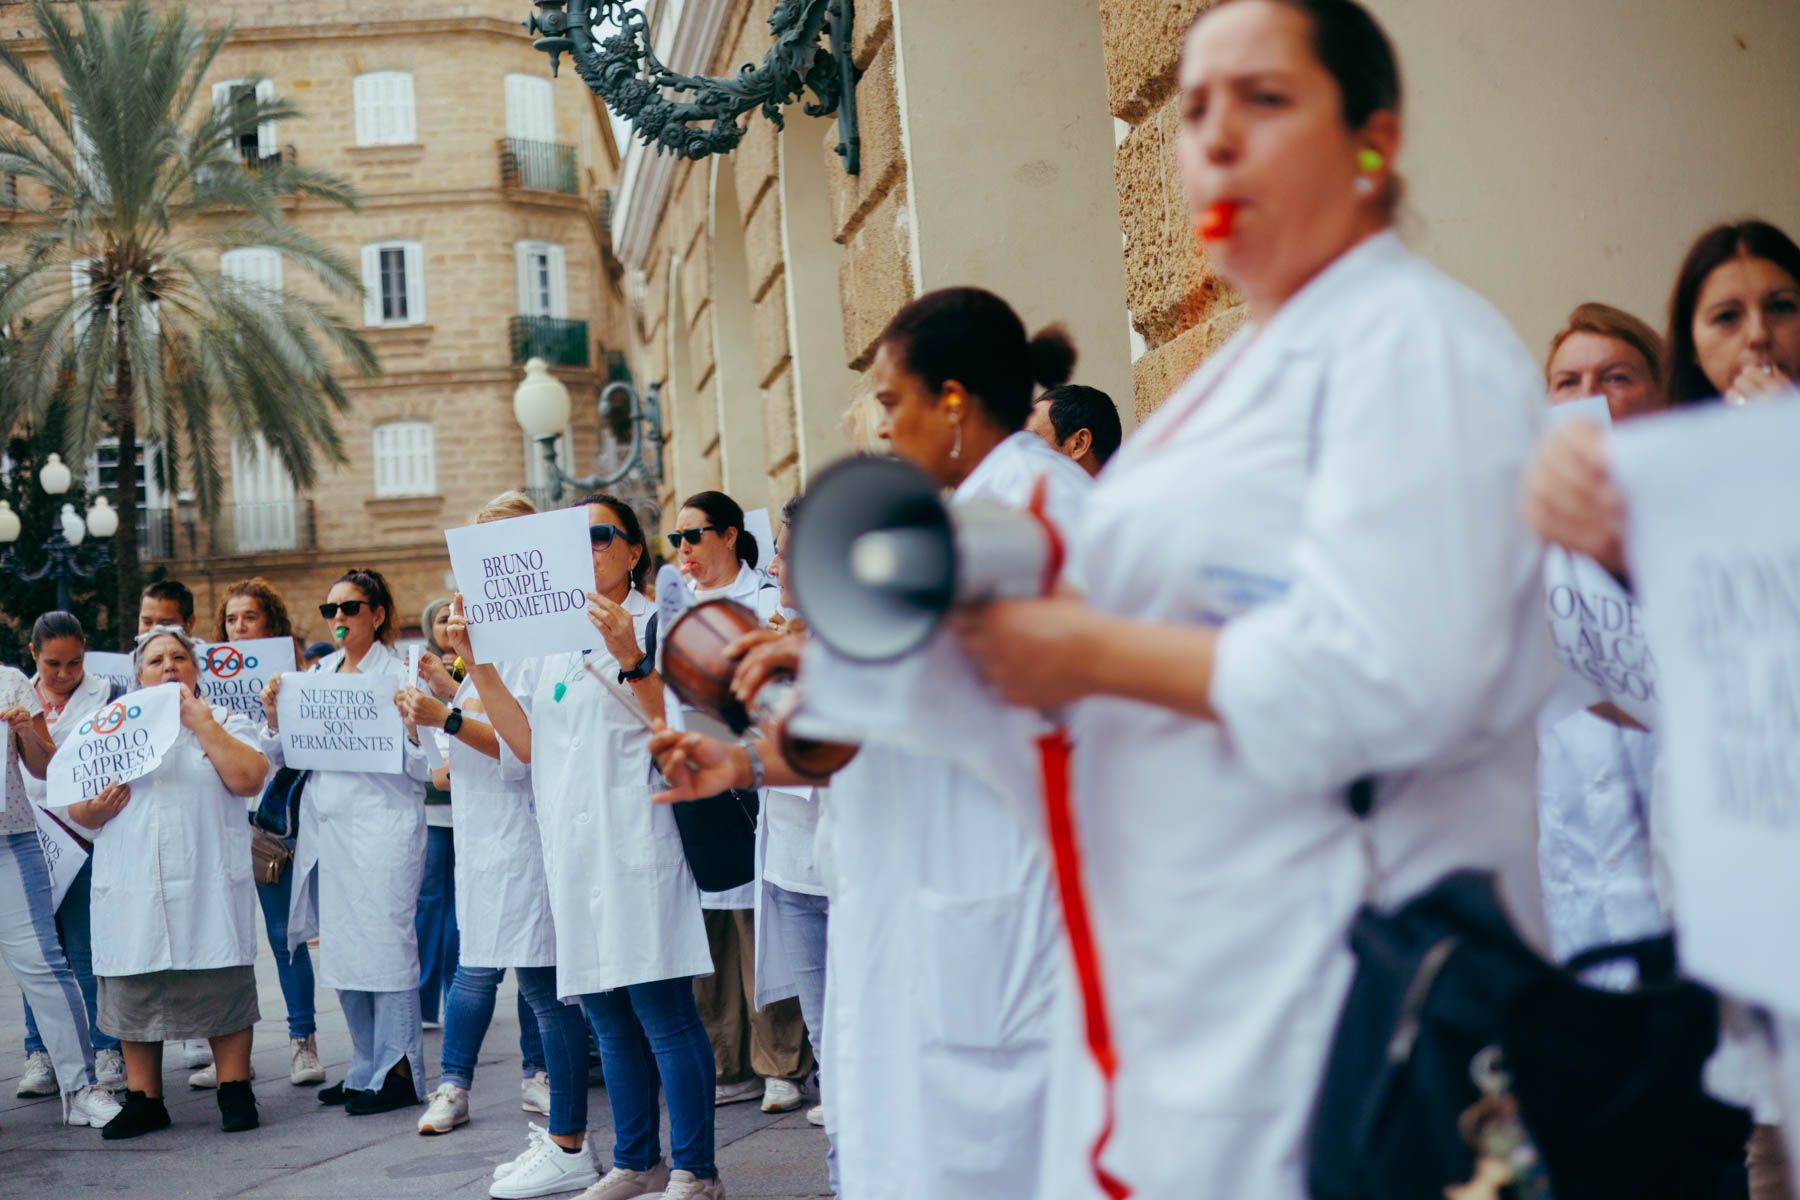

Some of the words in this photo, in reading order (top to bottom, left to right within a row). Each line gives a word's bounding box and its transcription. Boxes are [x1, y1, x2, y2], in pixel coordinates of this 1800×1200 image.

[482, 549, 543, 578] BRUNO
[484, 571, 552, 600] CUMPLE
[464, 604, 484, 625] LO
[486, 588, 586, 622] PROMETIDO
[300, 689, 374, 705] NUESTROS
[300, 705, 378, 720] DERECHOS
[323, 721, 354, 735] SON
[78, 728, 148, 761] ÓBOLO
[290, 735, 393, 751] PERMANENTES
[72, 745, 155, 782] EMPRESA
